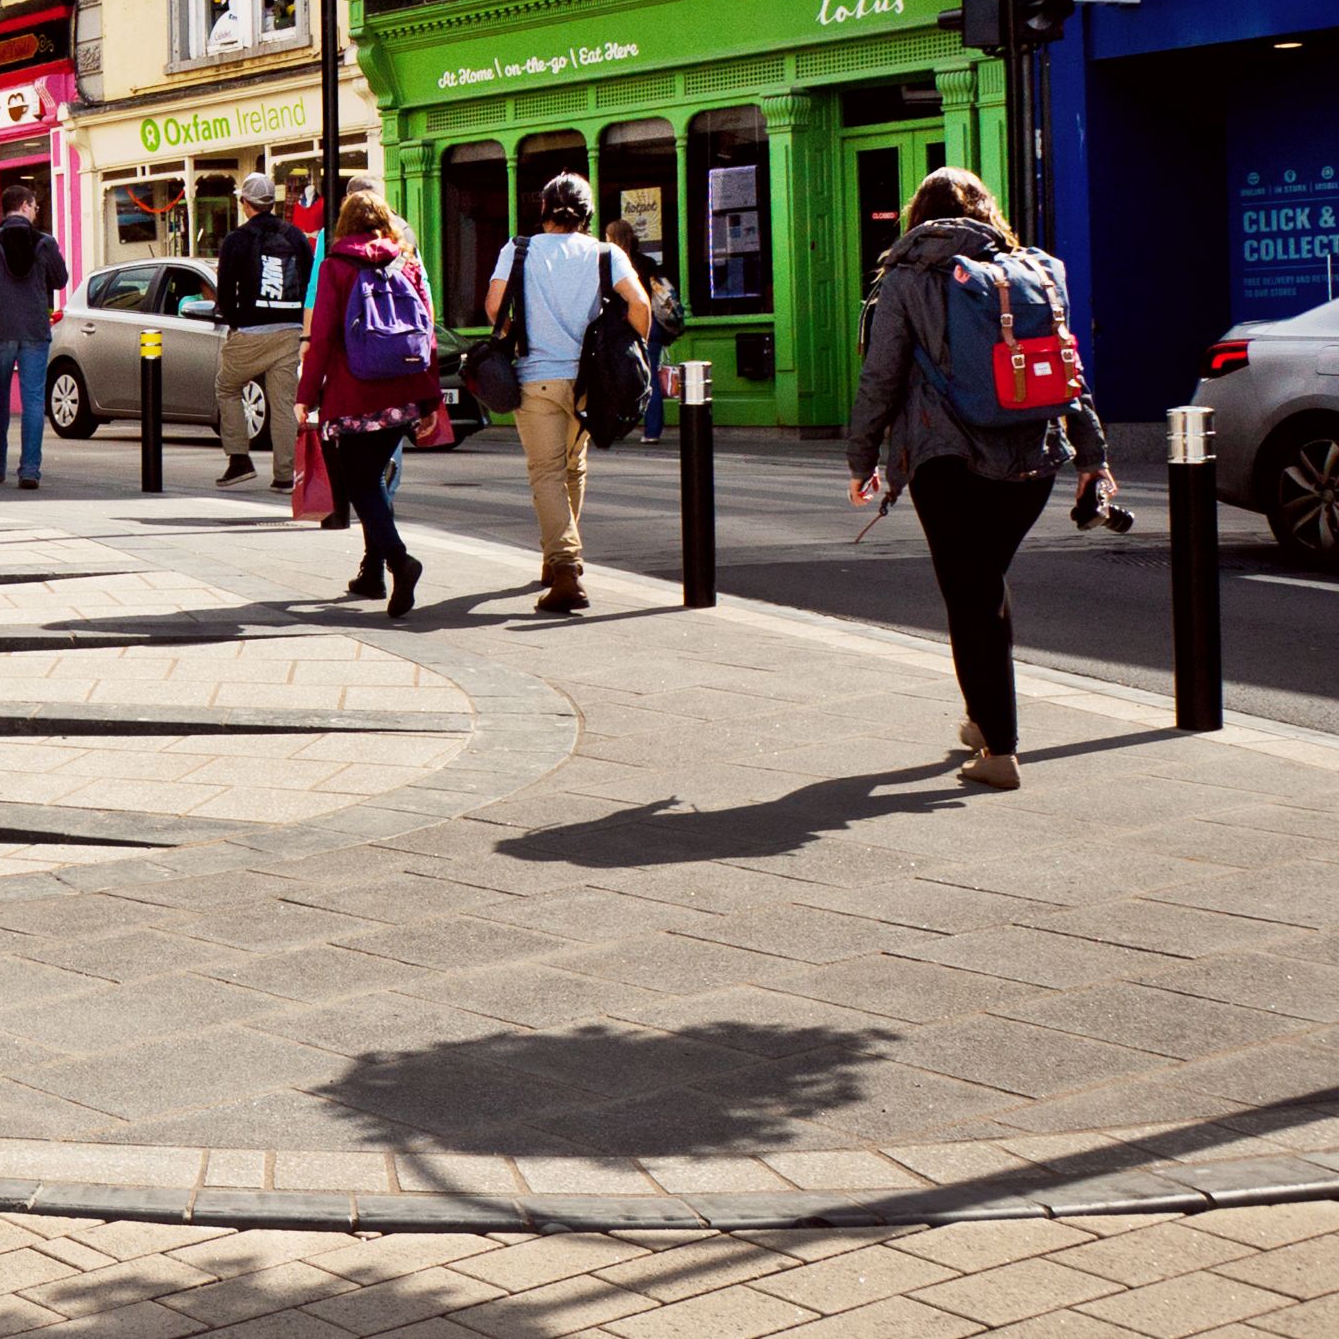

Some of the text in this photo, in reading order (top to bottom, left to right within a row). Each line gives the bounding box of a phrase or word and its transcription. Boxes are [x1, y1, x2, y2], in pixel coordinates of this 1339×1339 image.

[437, 42, 640, 89] At Home on-the-go Eat Here
[163, 96, 306, 146] Oxfam Ireland
[1243, 206, 1337, 234] CLICK &
[261, 254, 283, 300] NIKE
